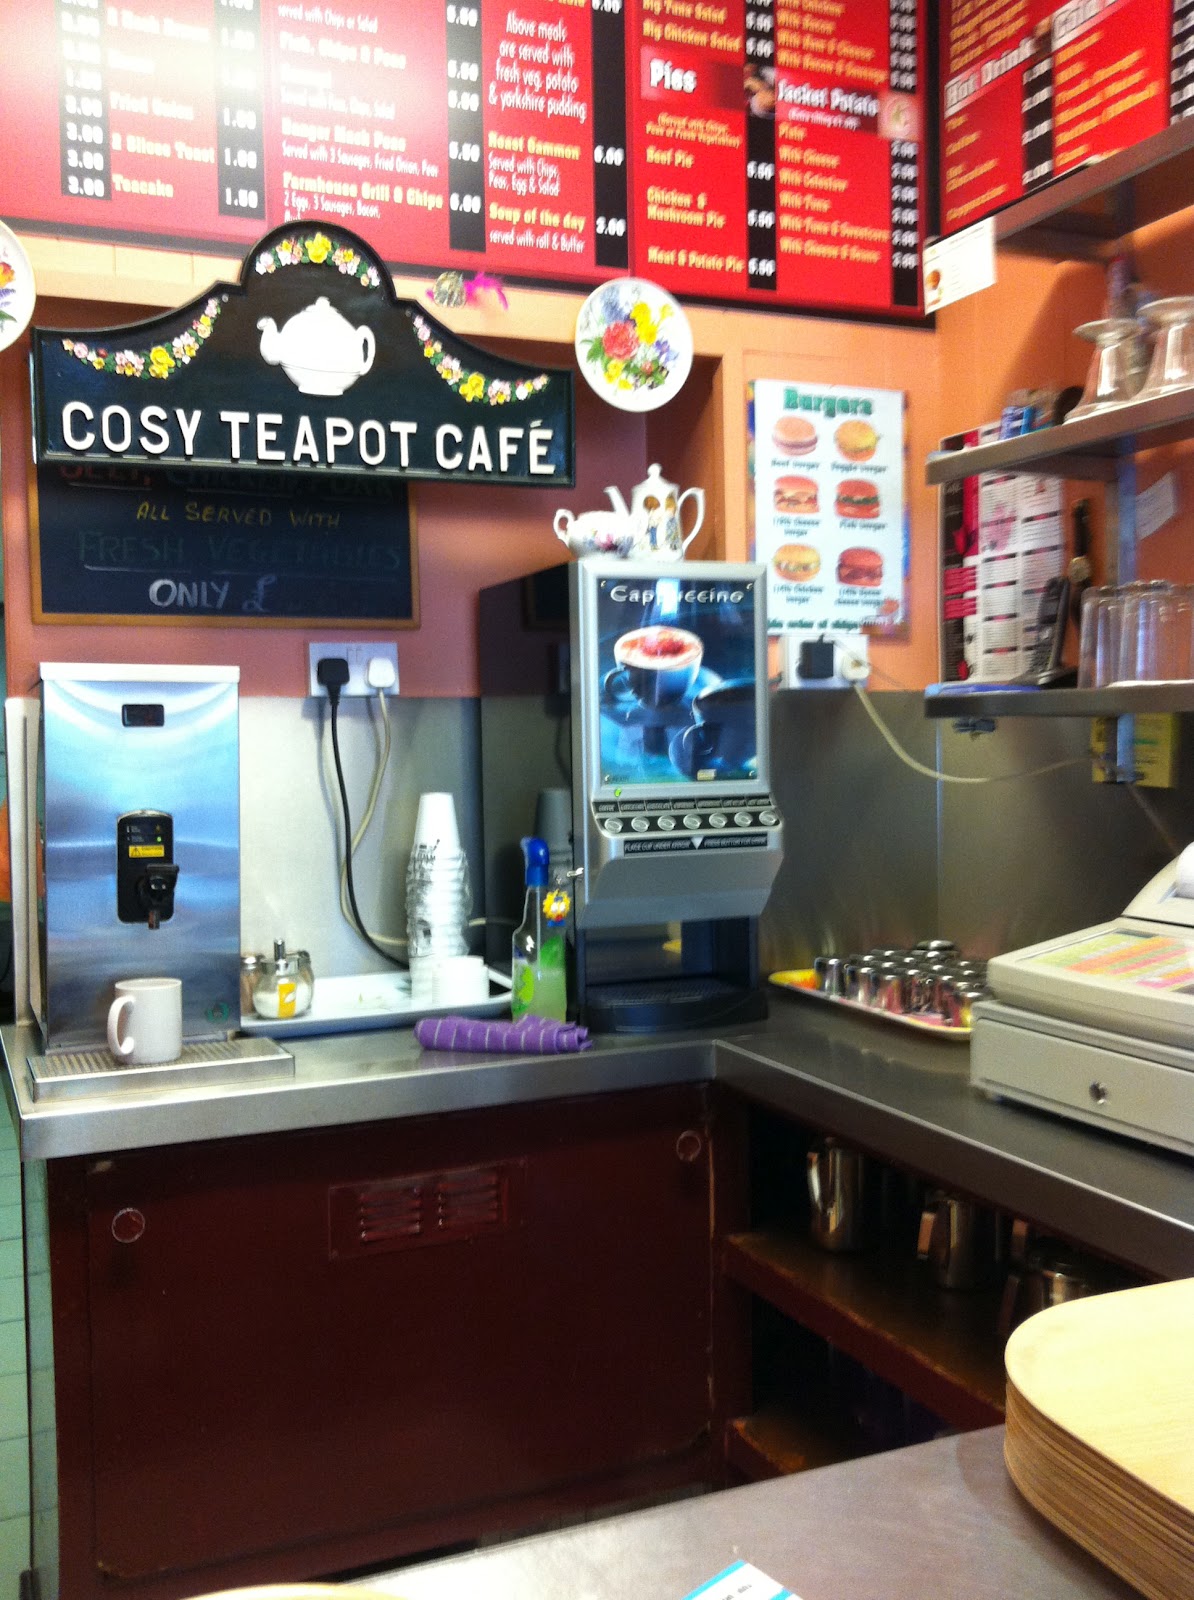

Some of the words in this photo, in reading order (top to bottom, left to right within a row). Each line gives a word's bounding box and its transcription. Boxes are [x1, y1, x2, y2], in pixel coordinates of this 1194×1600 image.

[304, 7, 323, 25] with
[506, 9, 537, 38] Above
[538, 18, 568, 42] meals
[695, 3, 728, 25] Salad
[643, 18, 663, 42] Big
[664, 22, 709, 46] Chicken
[499, 40, 516, 58] are
[519, 41, 550, 64] served
[552, 43, 575, 68] with
[496, 57, 520, 84] fresh
[546, 67, 579, 93] potato
[650, 58, 697, 94] Pies
[488, 81, 498, 105] &
[500, 85, 546, 112] yorkshire
[548, 92, 587, 124] pudding
[777, 78, 828, 109] Jacket
[830, 87, 880, 117] Potato
[282, 140, 307, 160] Served
[309, 144, 328, 164] with
[488, 130, 524, 153] Roast
[527, 136, 581, 160] Gammon
[674, 149, 695, 169] Pie
[489, 151, 515, 172] Served
[517, 156, 536, 174] with
[112, 174, 174, 198] Teacake
[282, 171, 358, 198] Farmhouse
[361, 181, 390, 202] Grill
[406, 187, 444, 212] Chips
[512, 172, 527, 196] Egg
[529, 174, 536, 194] &
[538, 176, 560, 196] Salad
[647, 185, 693, 208] Chicken
[284, 190, 290, 207] 2
[489, 201, 521, 225] Soup
[524, 207, 537, 224] of
[540, 208, 560, 228] the
[563, 211, 586, 233] day
[647, 203, 704, 227] Mushroom
[706, 210, 726, 229] Pie
[489, 227, 515, 246] served
[516, 228, 535, 247] with
[536, 230, 550, 249] roll
[551, 231, 560, 250] &
[561, 232, 585, 253] Butter
[648, 246, 676, 266] Meat
[689, 251, 724, 271] Potato
[725, 255, 746, 273] Pie
[783, 386, 874, 418] Burgers
[62, 401, 202, 456] COSY
[219, 410, 417, 468] TEAPOT
[435, 418, 557, 476] CAFÉ
[136, 501, 170, 521] ALL
[185, 501, 272, 527] SERVED
[289, 511, 342, 529] WITH
[79, 531, 183, 564] FRESH
[149, 578, 230, 609] ONLY
[610, 584, 745, 606] Capccino
